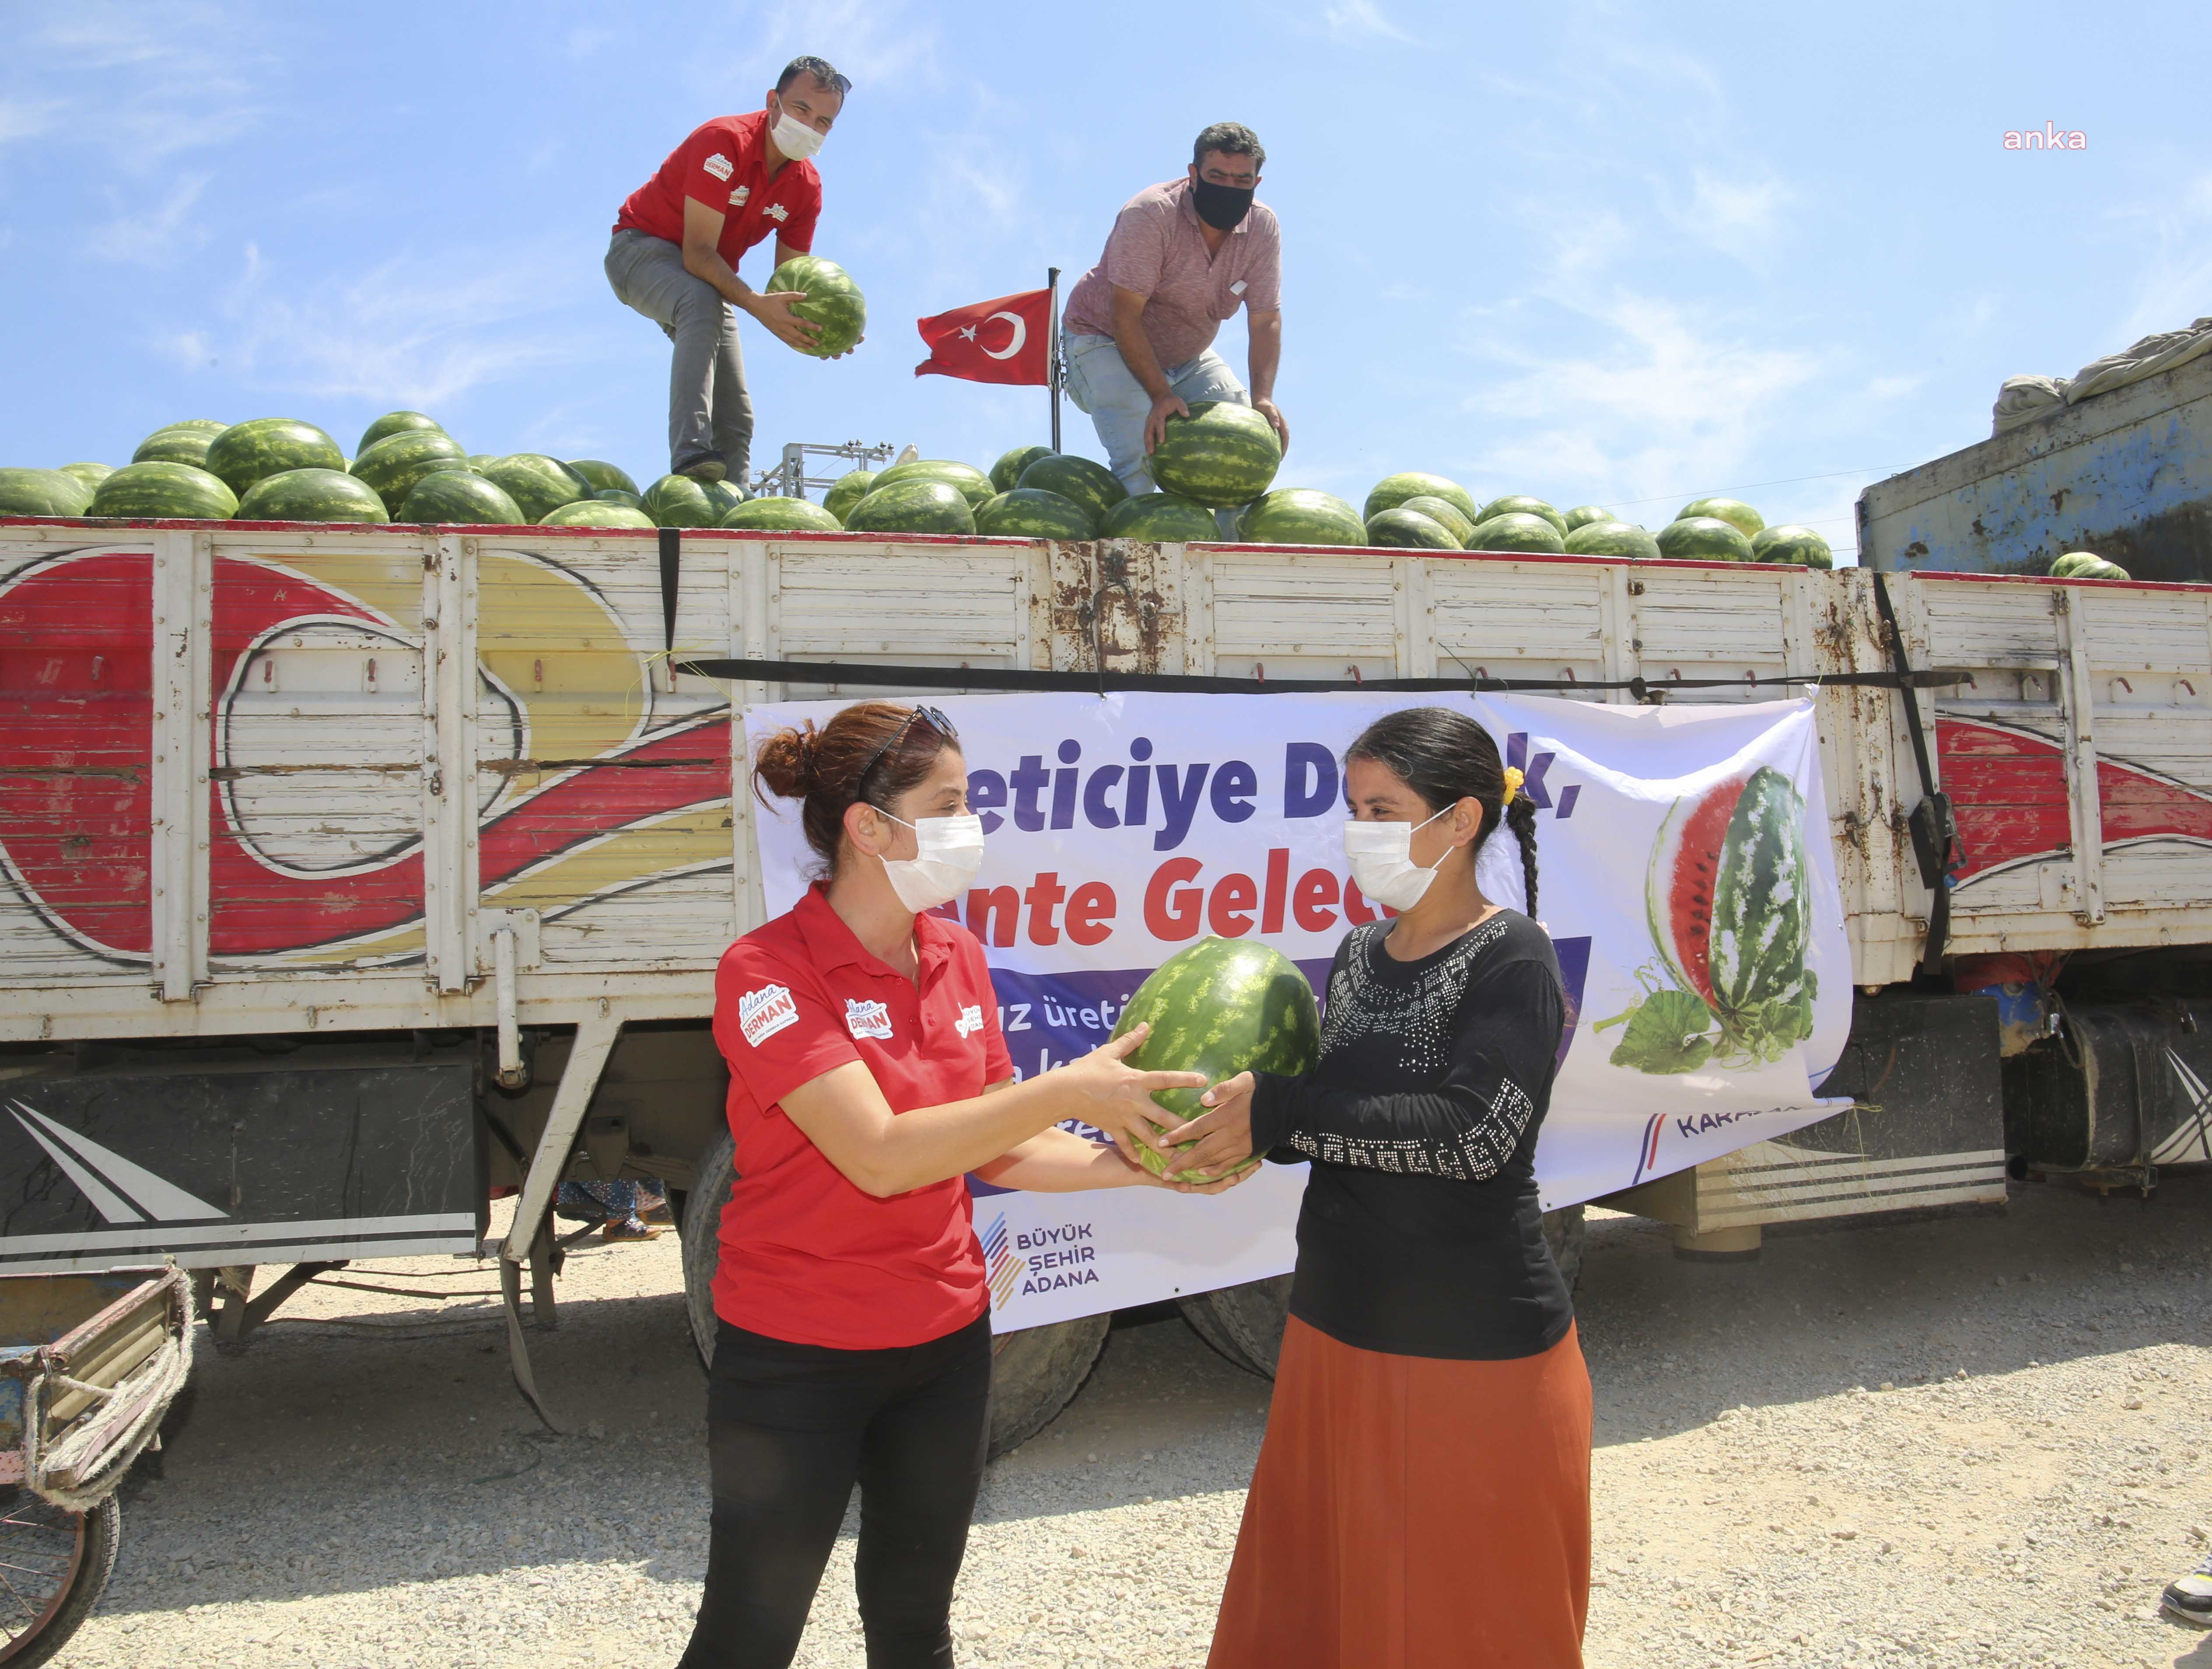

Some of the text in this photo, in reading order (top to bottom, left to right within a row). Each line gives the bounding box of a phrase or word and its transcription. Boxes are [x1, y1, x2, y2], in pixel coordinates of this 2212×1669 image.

[706, 161, 730, 176] DERMAN
[966, 737, 1257, 851] eticiye
[928, 872, 1117, 948] nte
[741, 987, 777, 1021] Adana
[745, 994, 792, 1039] DERMAN
[1017, 1223, 1092, 1250] BÜYÜK
[1028, 1245, 1095, 1276] ŞEHİR
[1022, 1269, 1099, 1296] ADANA
